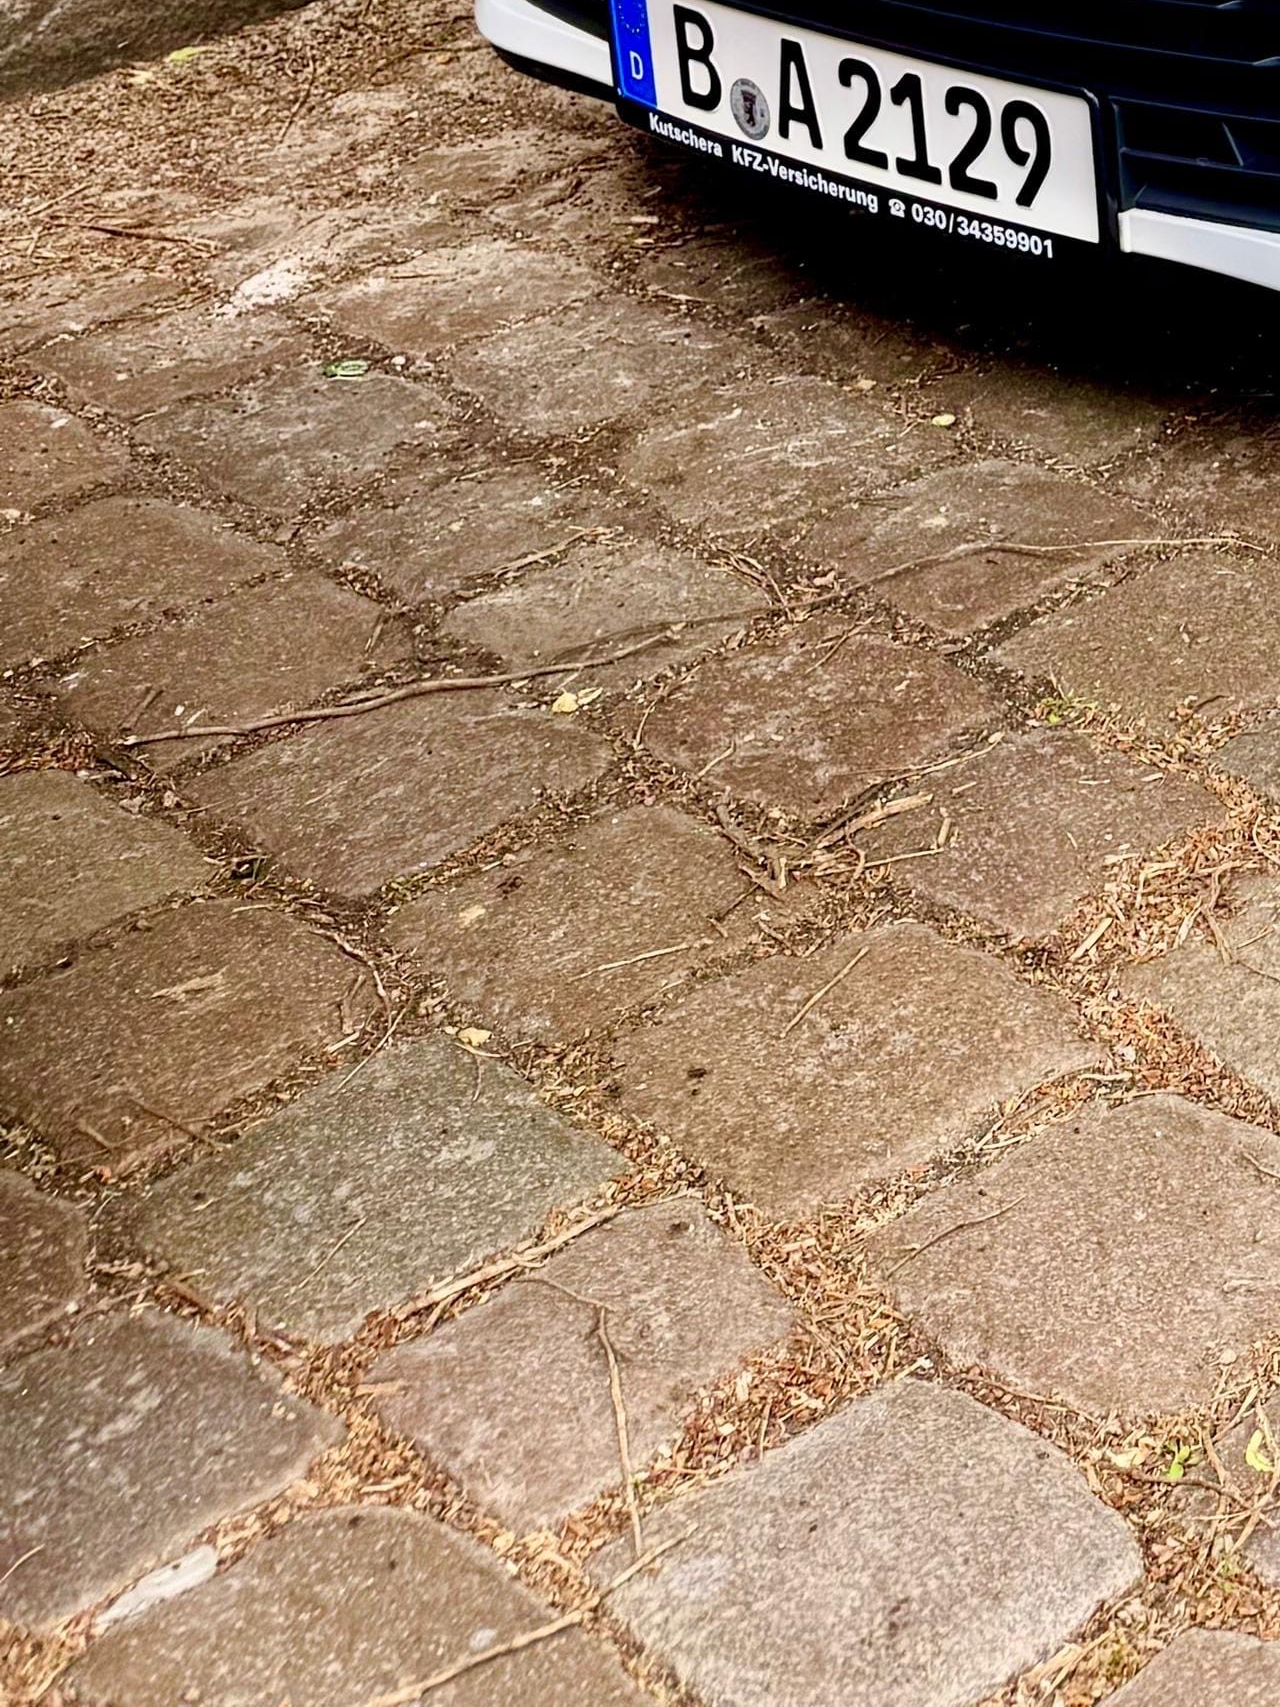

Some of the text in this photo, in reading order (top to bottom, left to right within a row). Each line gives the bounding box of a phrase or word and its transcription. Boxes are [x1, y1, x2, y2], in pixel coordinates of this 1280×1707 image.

[629, 50, 645, 81] D
[673, 3, 722, 113] B
[649, 111, 1054, 259] Kutschera KFZ-Versicherung 030/34359901
